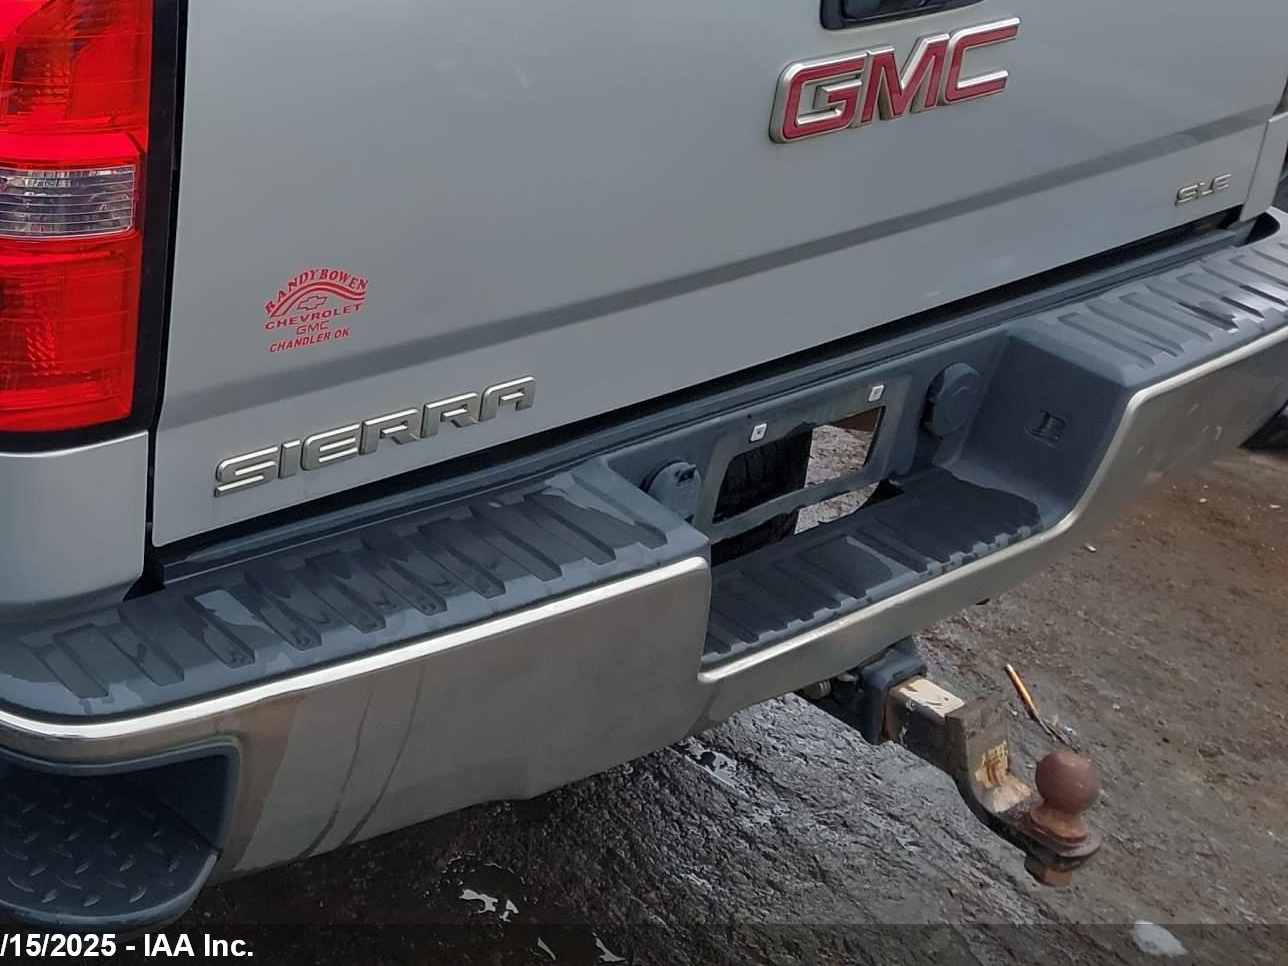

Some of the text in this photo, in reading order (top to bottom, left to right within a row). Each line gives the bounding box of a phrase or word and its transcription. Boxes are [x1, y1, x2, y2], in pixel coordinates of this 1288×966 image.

[768, 17, 1021, 144] GMC
[1174, 173, 1232, 204] SLE
[265, 268, 369, 315] RANDY BOWEN
[265, 303, 363, 330] CHEVROLET
[296, 320, 330, 335] GMC
[269, 327, 350, 353] CHANDLER OK
[214, 375, 536, 498] SIERRA
